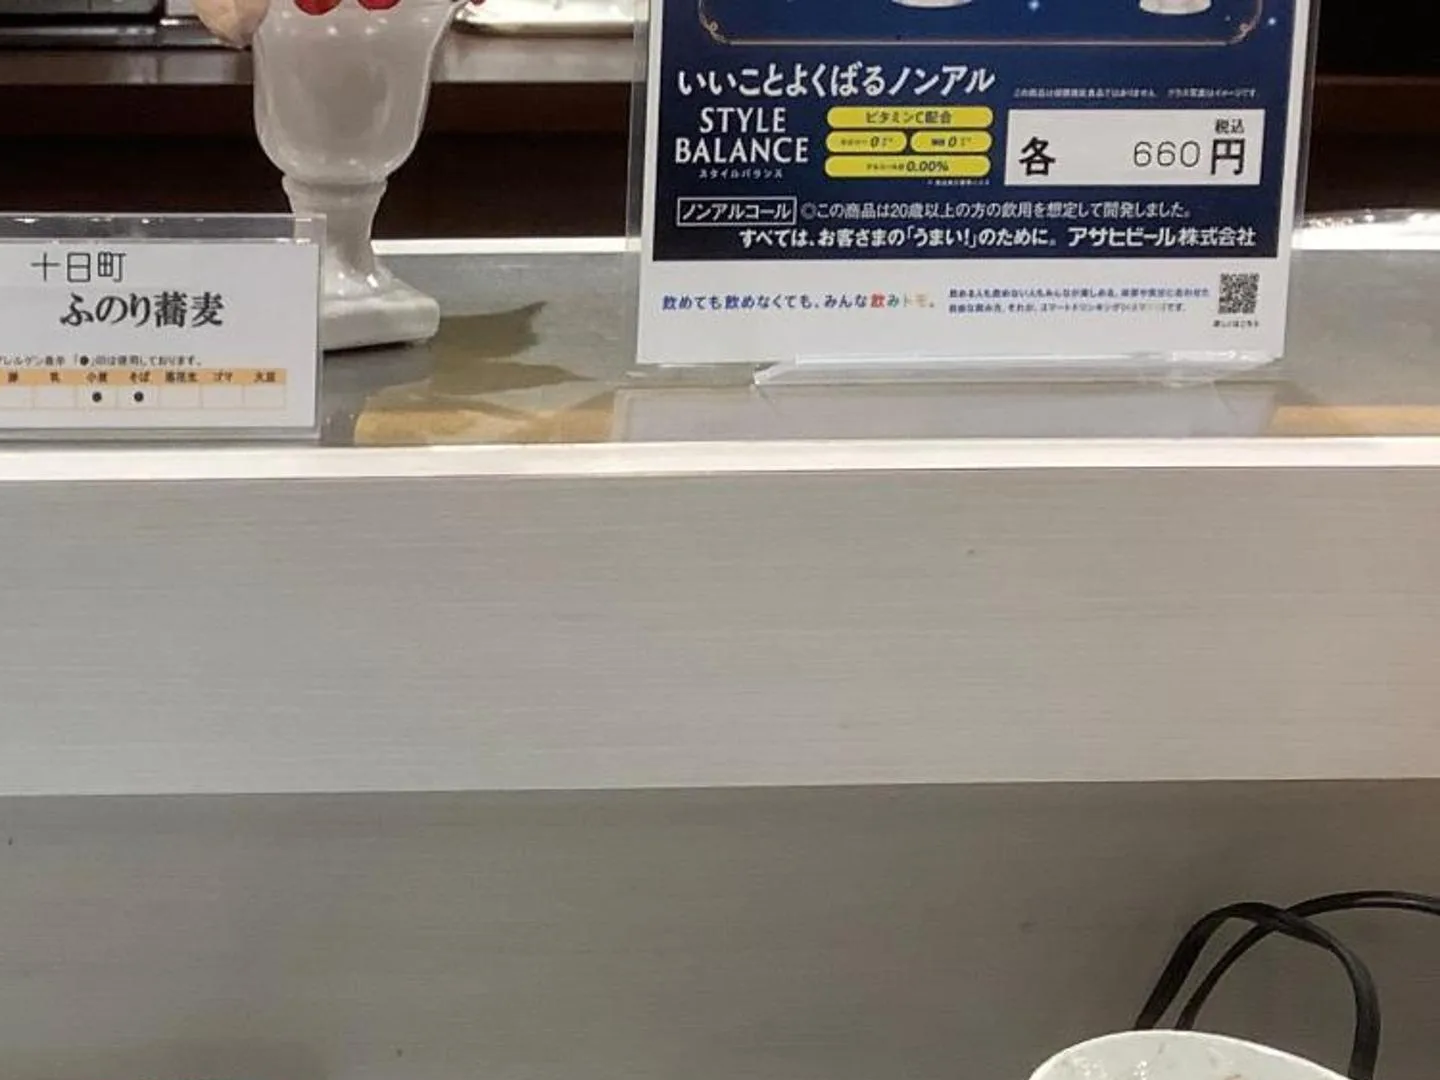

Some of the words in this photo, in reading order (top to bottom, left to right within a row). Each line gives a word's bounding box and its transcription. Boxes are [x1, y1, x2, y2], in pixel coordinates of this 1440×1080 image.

[677, 62, 996, 98] いいことよくばるノンアル
[699, 107, 787, 134] STYLE
[1214, 118, 1245, 135] 税込
[674, 137, 809, 164] BALANCE
[1017, 136, 1056, 177] 各
[1132, 140, 1201, 168] 660
[1210, 137, 1245, 176] 円
[698, 168, 784, 181] スタイルバランス
[681, 202, 792, 220] ノンアルコール
[1067, 226, 1257, 247] アサヒビール株式会社
[29, 251, 128, 284] 十日町
[59, 291, 225, 329] ふのり蕎麦
